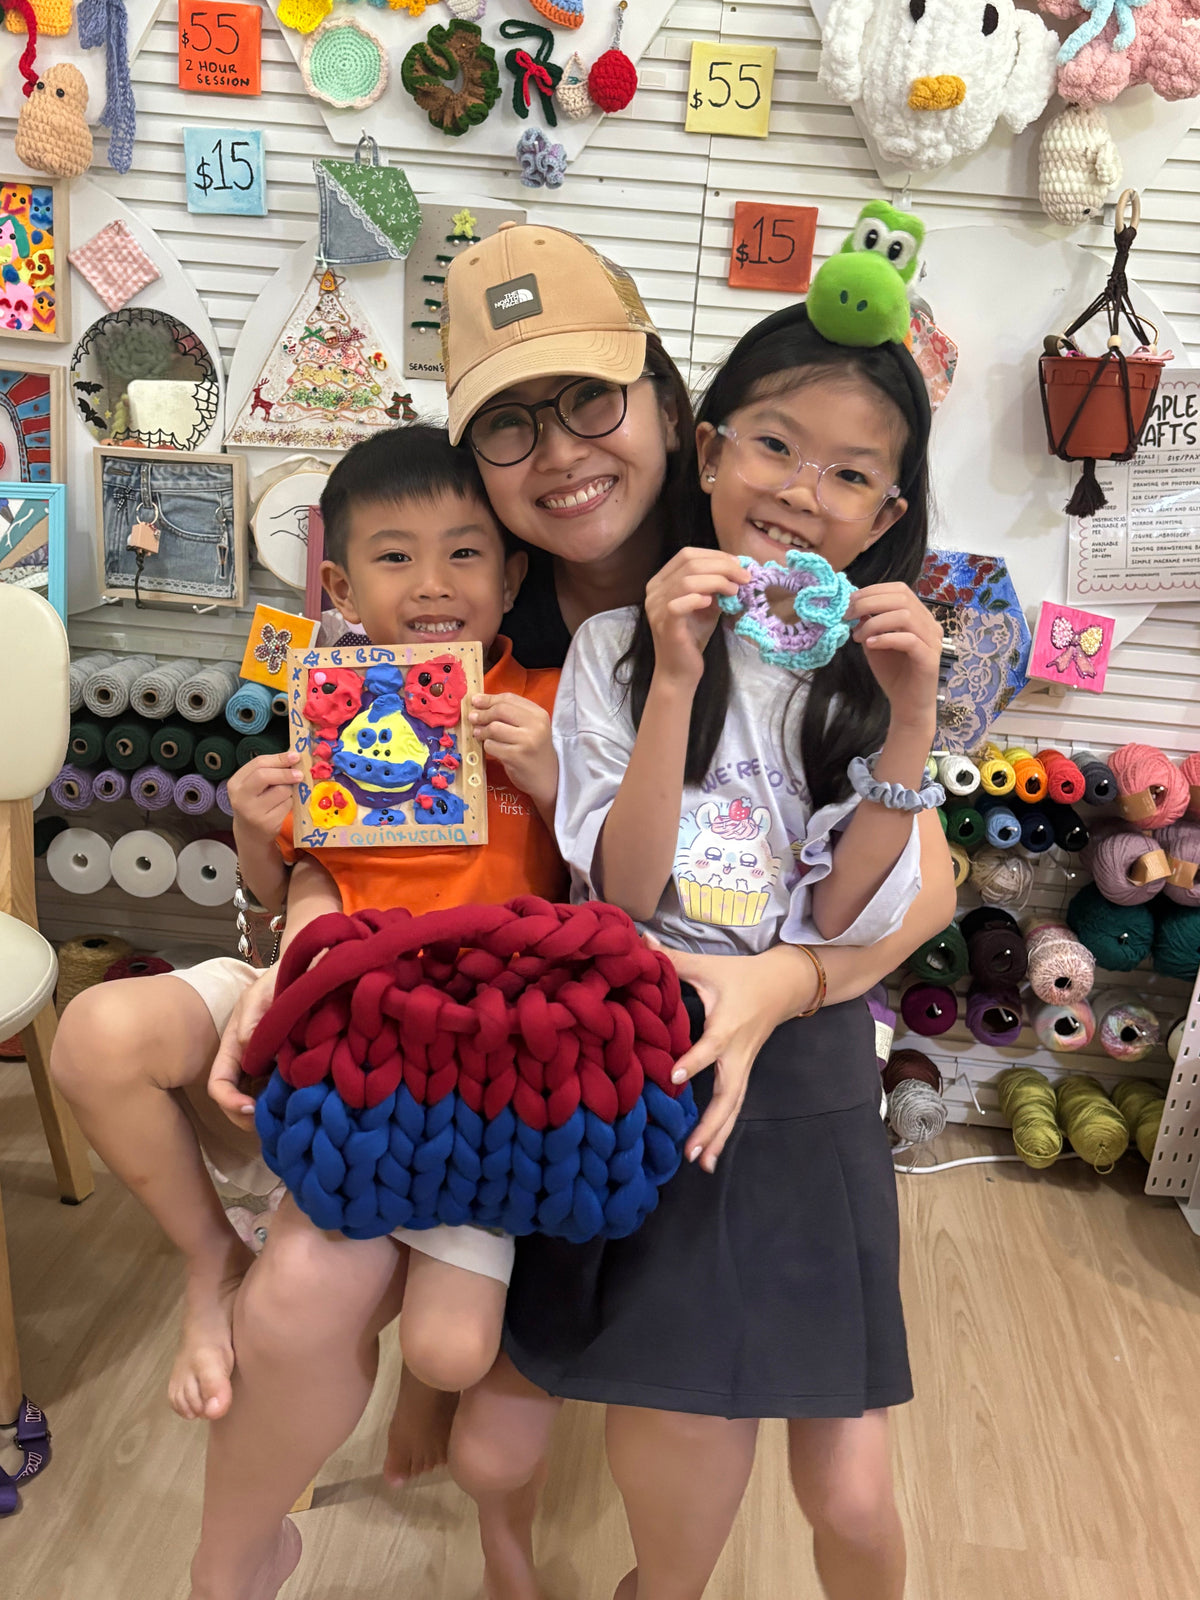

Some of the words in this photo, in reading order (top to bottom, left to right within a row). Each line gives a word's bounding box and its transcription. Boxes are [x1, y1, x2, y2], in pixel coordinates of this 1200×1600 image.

[182, 12, 240, 54] $55
[185, 59, 193, 71] 2
[199, 61, 238, 74] HOUR
[197, 74, 250, 87] SESSION
[689, 61, 762, 110] $55
[193, 139, 255, 196] $15
[735, 216, 796, 269] $15
[409, 362, 445, 373] SEASON'S
[1139, 421, 1198, 447] AFTS
[500, 792, 520, 805] my
[500, 802, 524, 816] first
